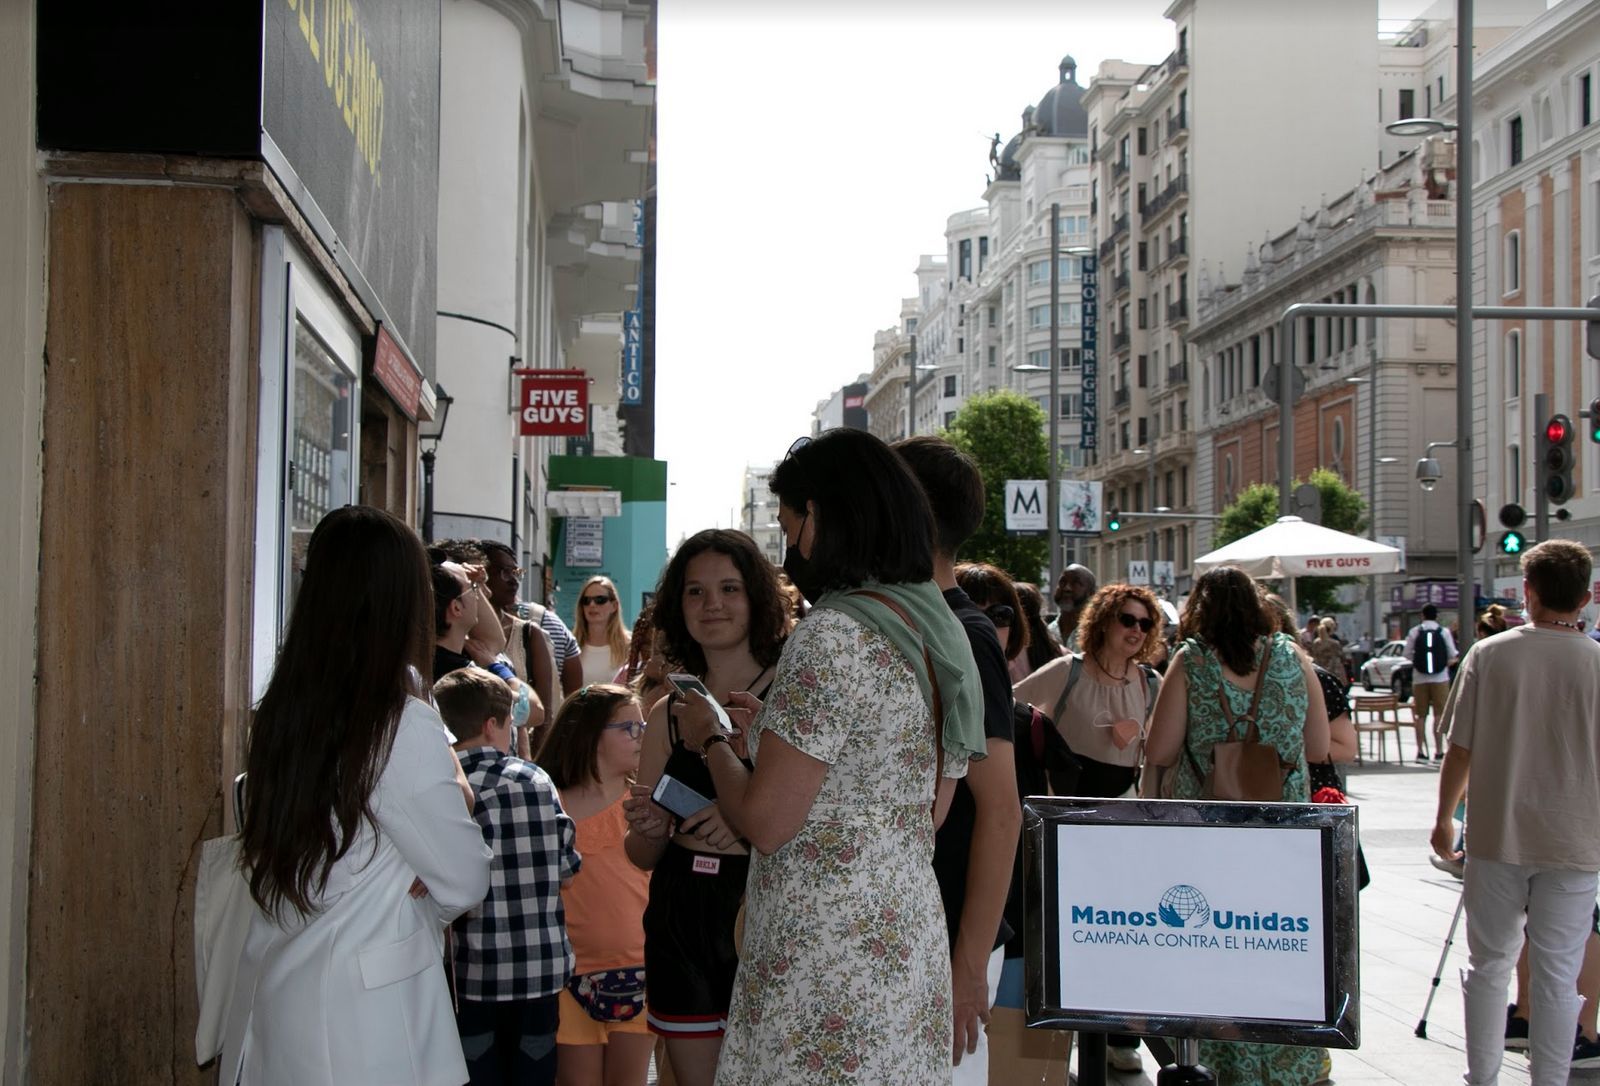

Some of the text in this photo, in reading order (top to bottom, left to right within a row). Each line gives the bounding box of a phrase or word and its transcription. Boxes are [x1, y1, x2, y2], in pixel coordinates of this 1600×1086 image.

[627, 310, 640, 400] ANTICO
[1083, 272, 1096, 447] HOTEL REGENTE
[529, 390, 578, 406] FIVE
[523, 407, 584, 424] GUYS
[1306, 557, 1370, 568] FIVE GUYS
[1071, 905, 1310, 933] Manos Unidas
[1072, 928, 1308, 952] CAMPAÑA CONTRA EL HAMBRE
